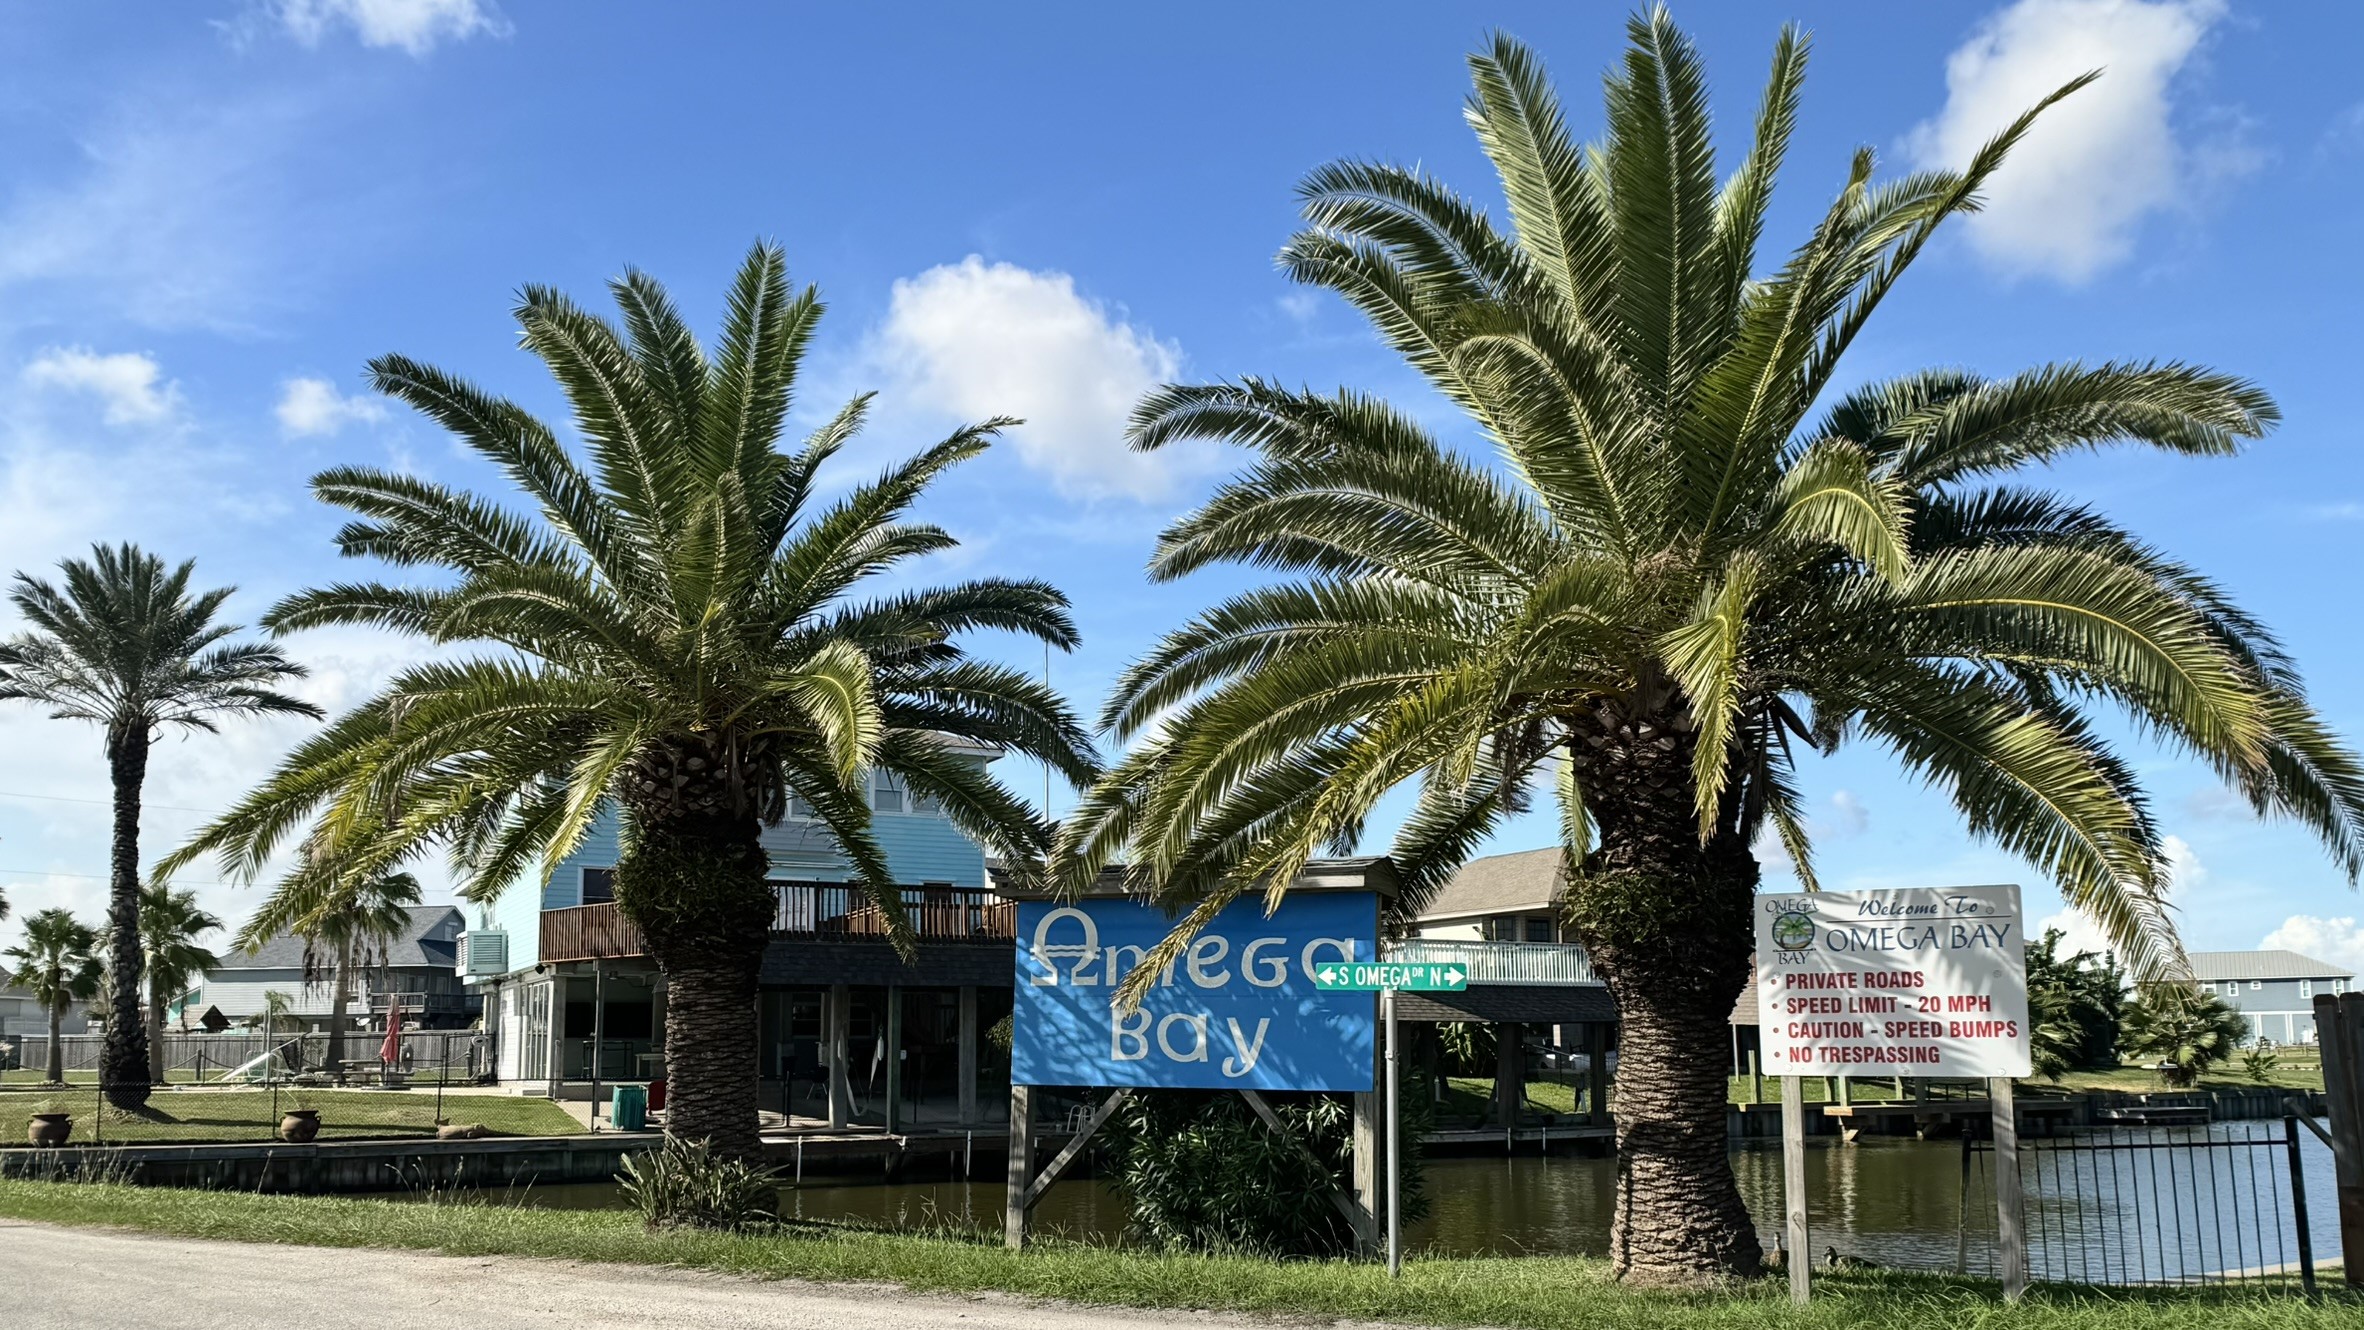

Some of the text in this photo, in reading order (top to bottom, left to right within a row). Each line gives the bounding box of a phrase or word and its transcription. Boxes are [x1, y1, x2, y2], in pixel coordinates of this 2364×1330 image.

[1765, 897, 1819, 914] OMEGA
[1858, 895, 1979, 916] Welcome To
[1826, 923, 2011, 952] OMEGA BAY
[1777, 951, 1810, 965] BAY
[1338, 966, 1441, 986] S OMEGA DR N
[1785, 971, 1925, 989] PRIVATE ROADS
[1786, 997, 1842, 1014] SPEED
[1848, 996, 1898, 1013] LIMIT
[1918, 995, 1941, 1013] 20
[1948, 995, 1991, 1012] MPH
[1788, 1021, 1864, 1038] CAUTION
[1885, 1021, 1943, 1038] SPEED
[1950, 1020, 2018, 1038] BUMPS
[1110, 1005, 1270, 1078] Bay
[1789, 1046, 1940, 1063] NO TRESPASSING
